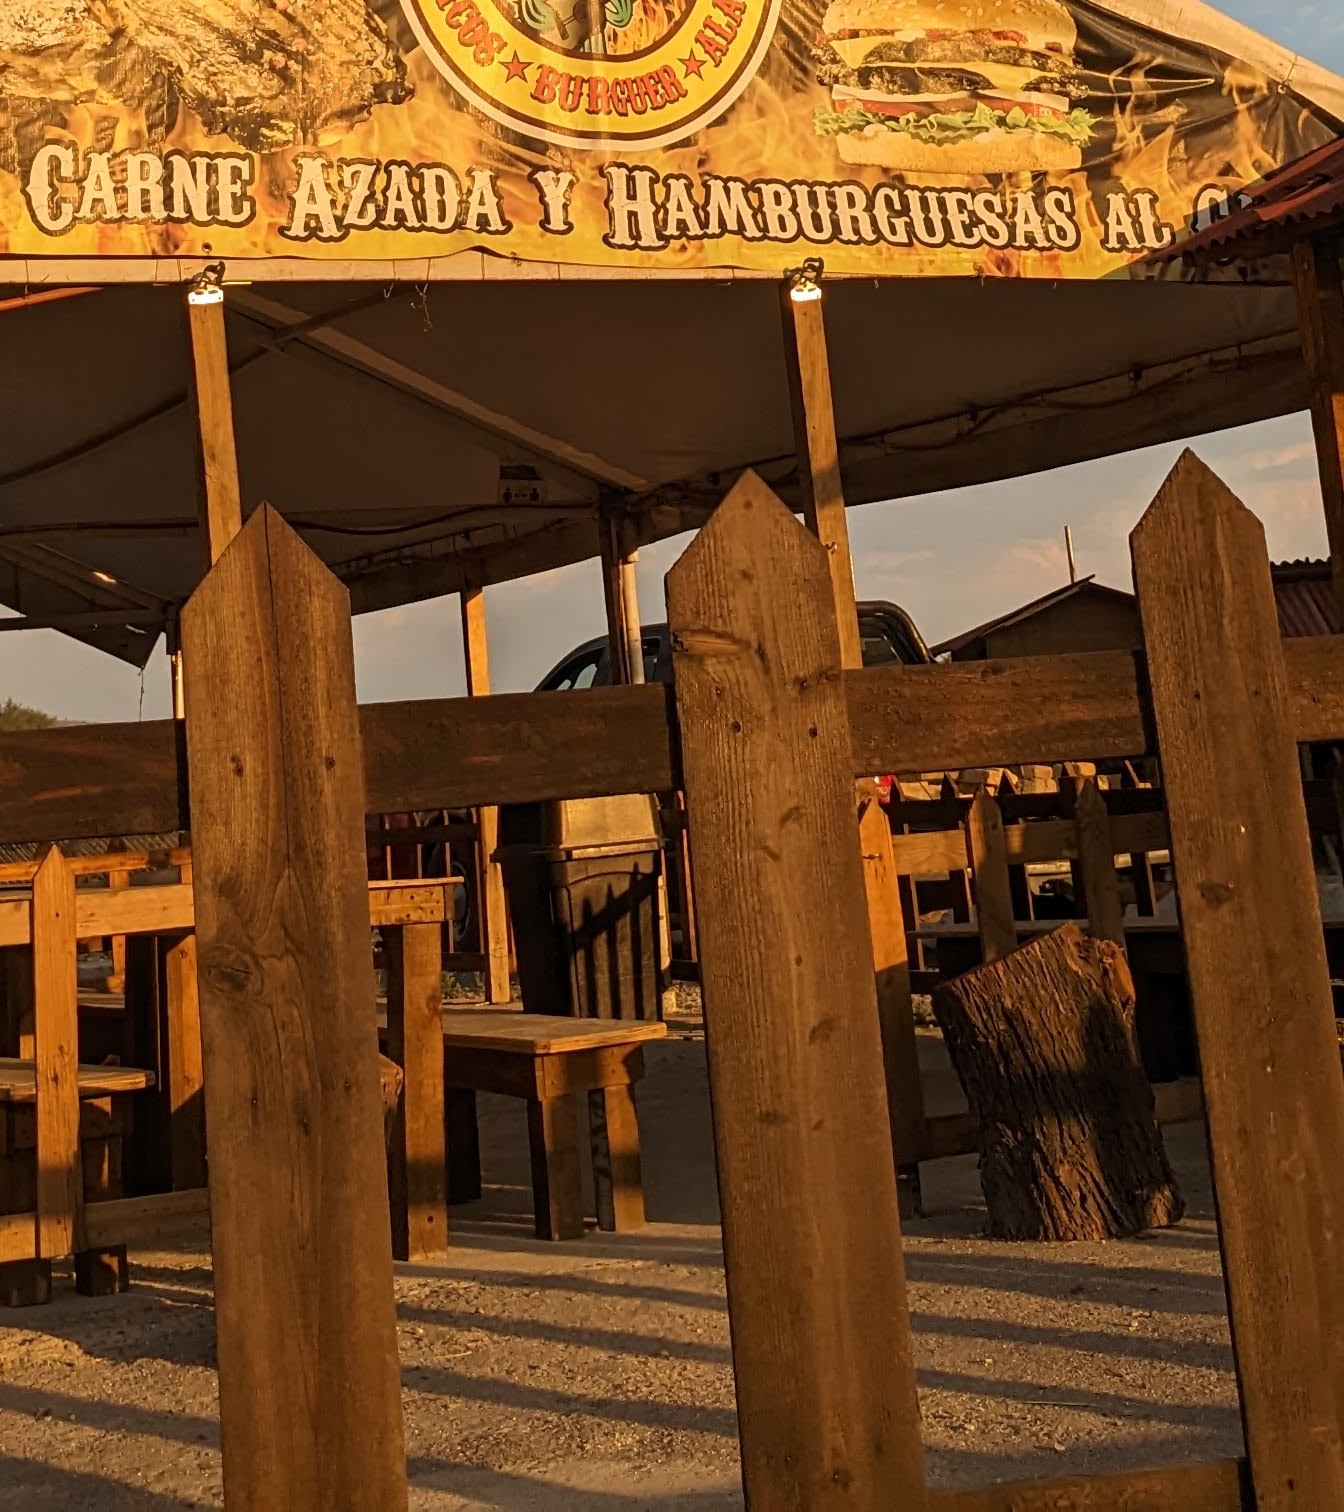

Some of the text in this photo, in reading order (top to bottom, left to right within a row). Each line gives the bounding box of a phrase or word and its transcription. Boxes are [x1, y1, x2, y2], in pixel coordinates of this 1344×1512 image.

[531, 63, 689, 117] BURGUER
[23, 137, 256, 236] CARNE
[279, 151, 509, 241] AZADA
[533, 162, 581, 236] Y
[601, 162, 1079, 252] HAMBURGUESAS
[1101, 190, 1173, 251] AL
